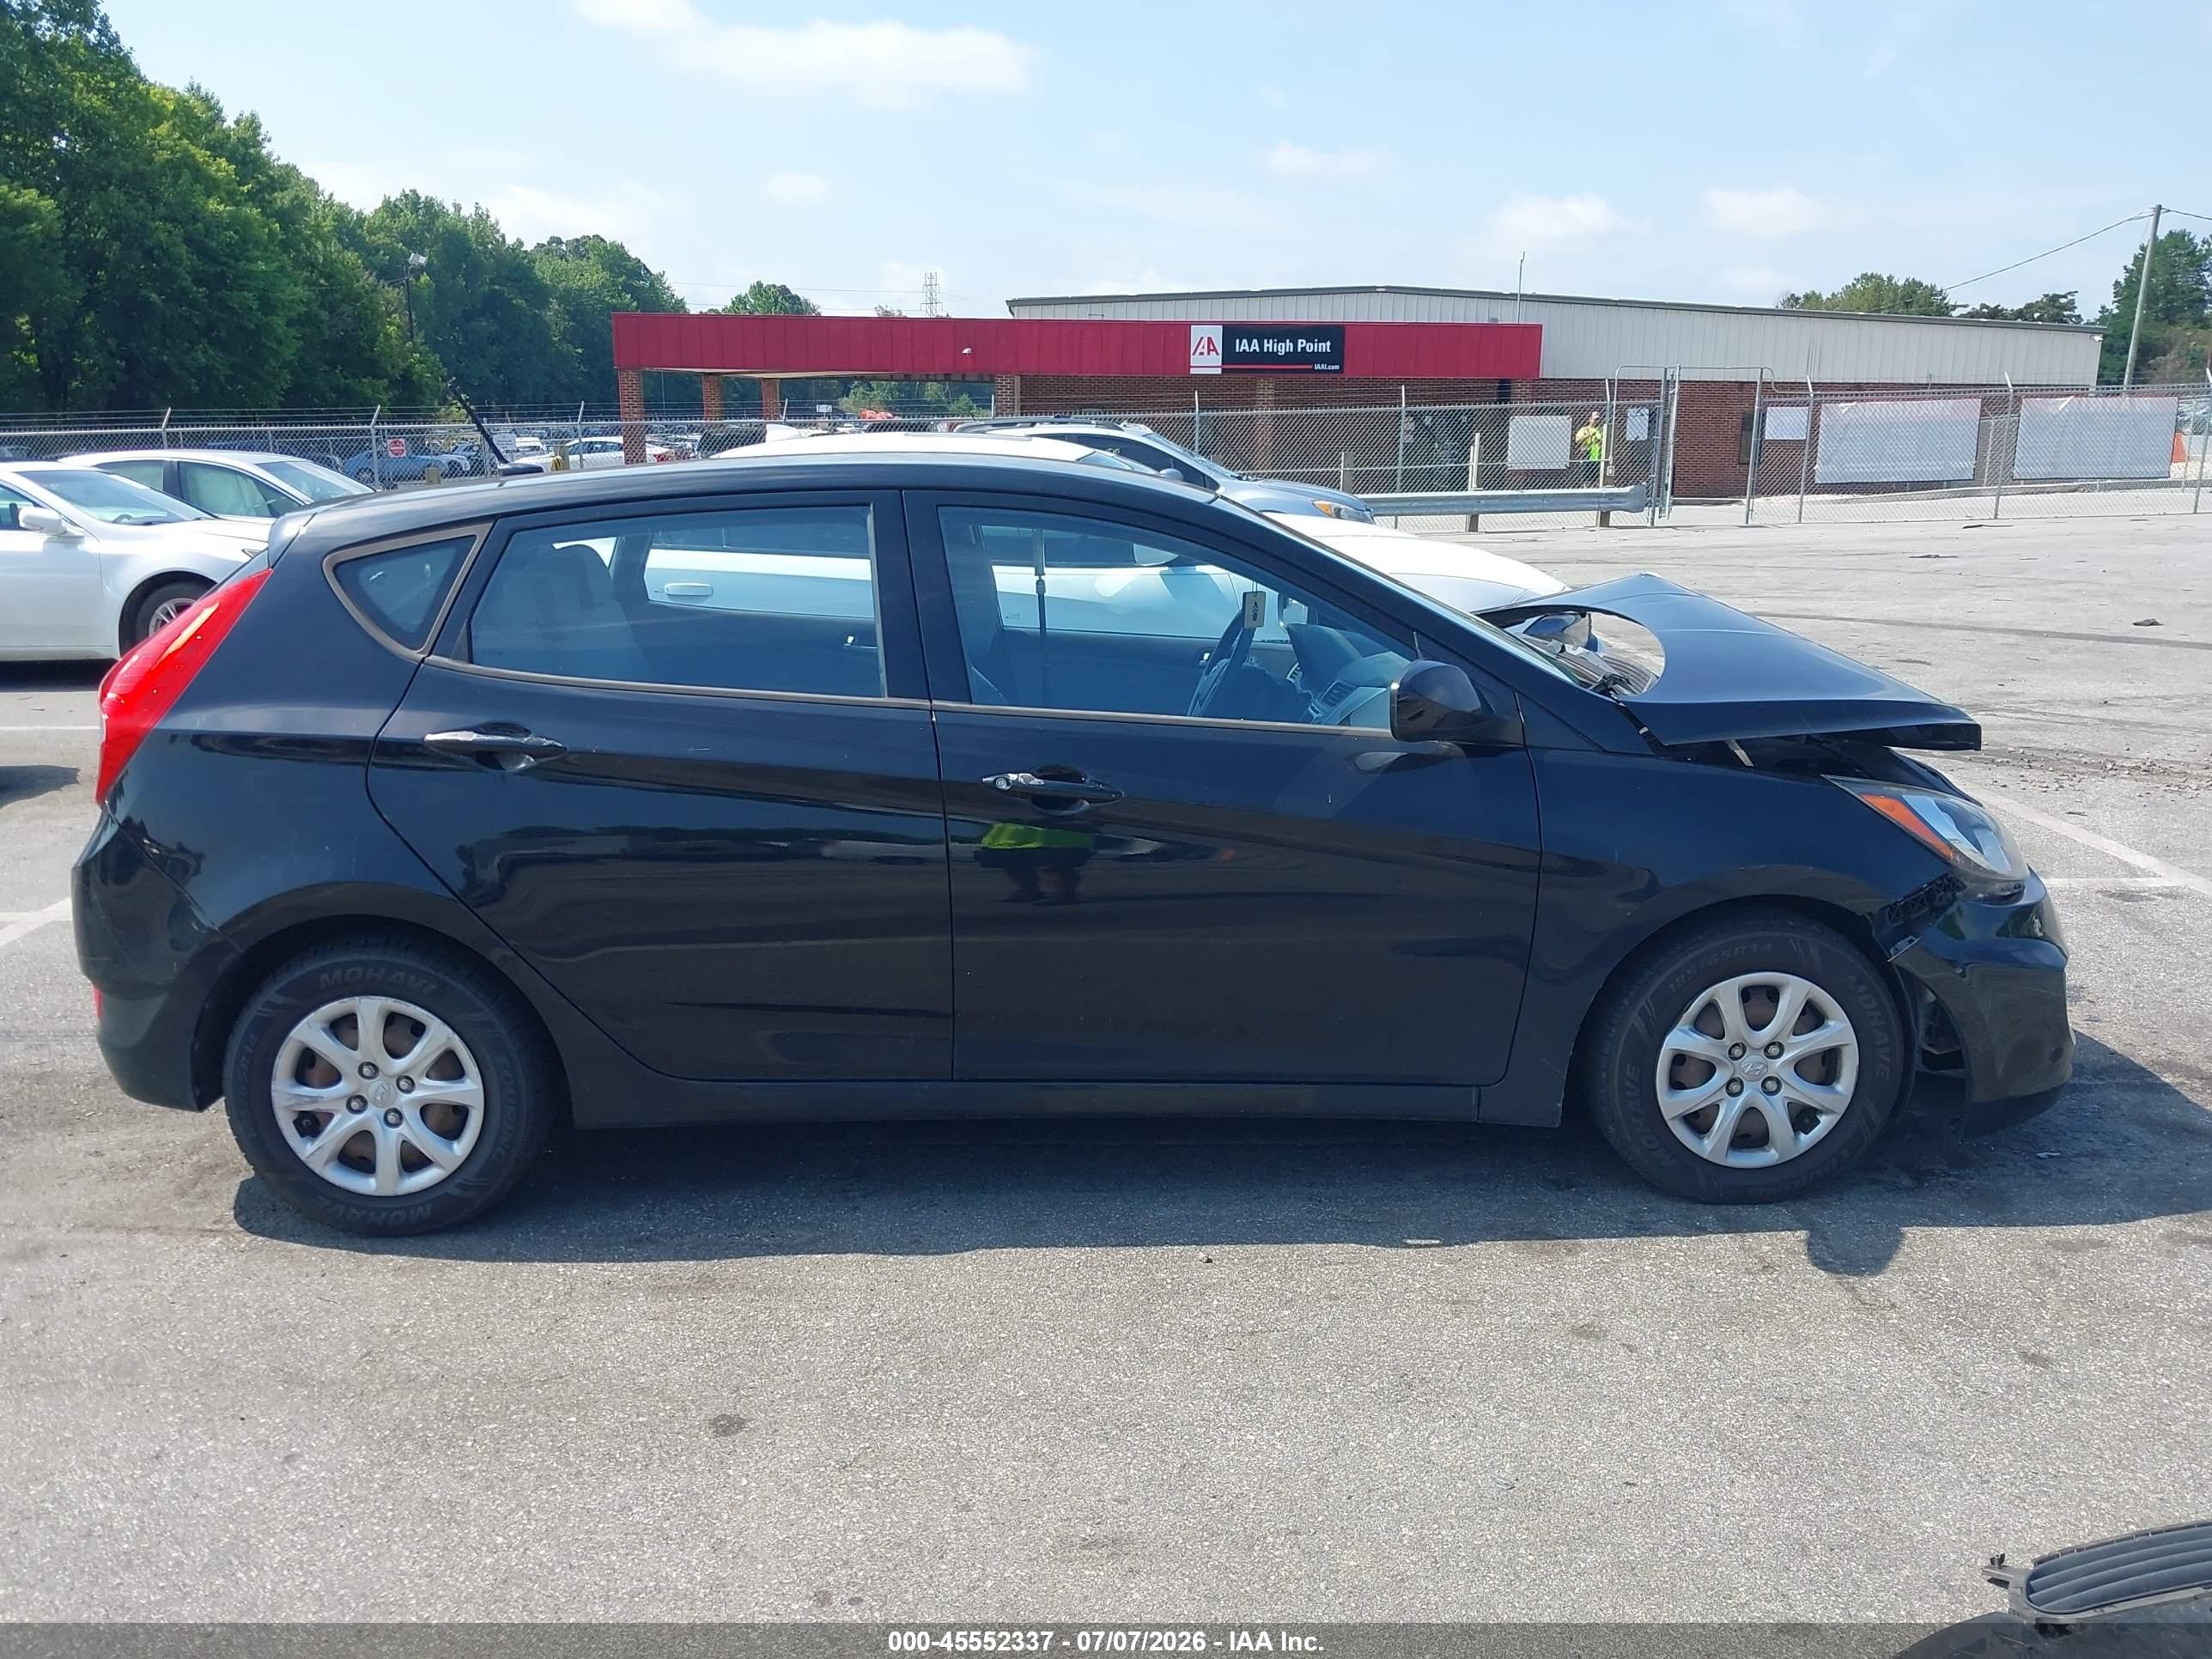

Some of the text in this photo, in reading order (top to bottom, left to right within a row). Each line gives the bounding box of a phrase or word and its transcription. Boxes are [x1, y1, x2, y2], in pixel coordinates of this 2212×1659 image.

[1235, 337, 1332, 356] IAA High Point
[1847, 975, 1891, 1085] MOHAVE
[1622, 1062, 1679, 1167] MOHAVE
